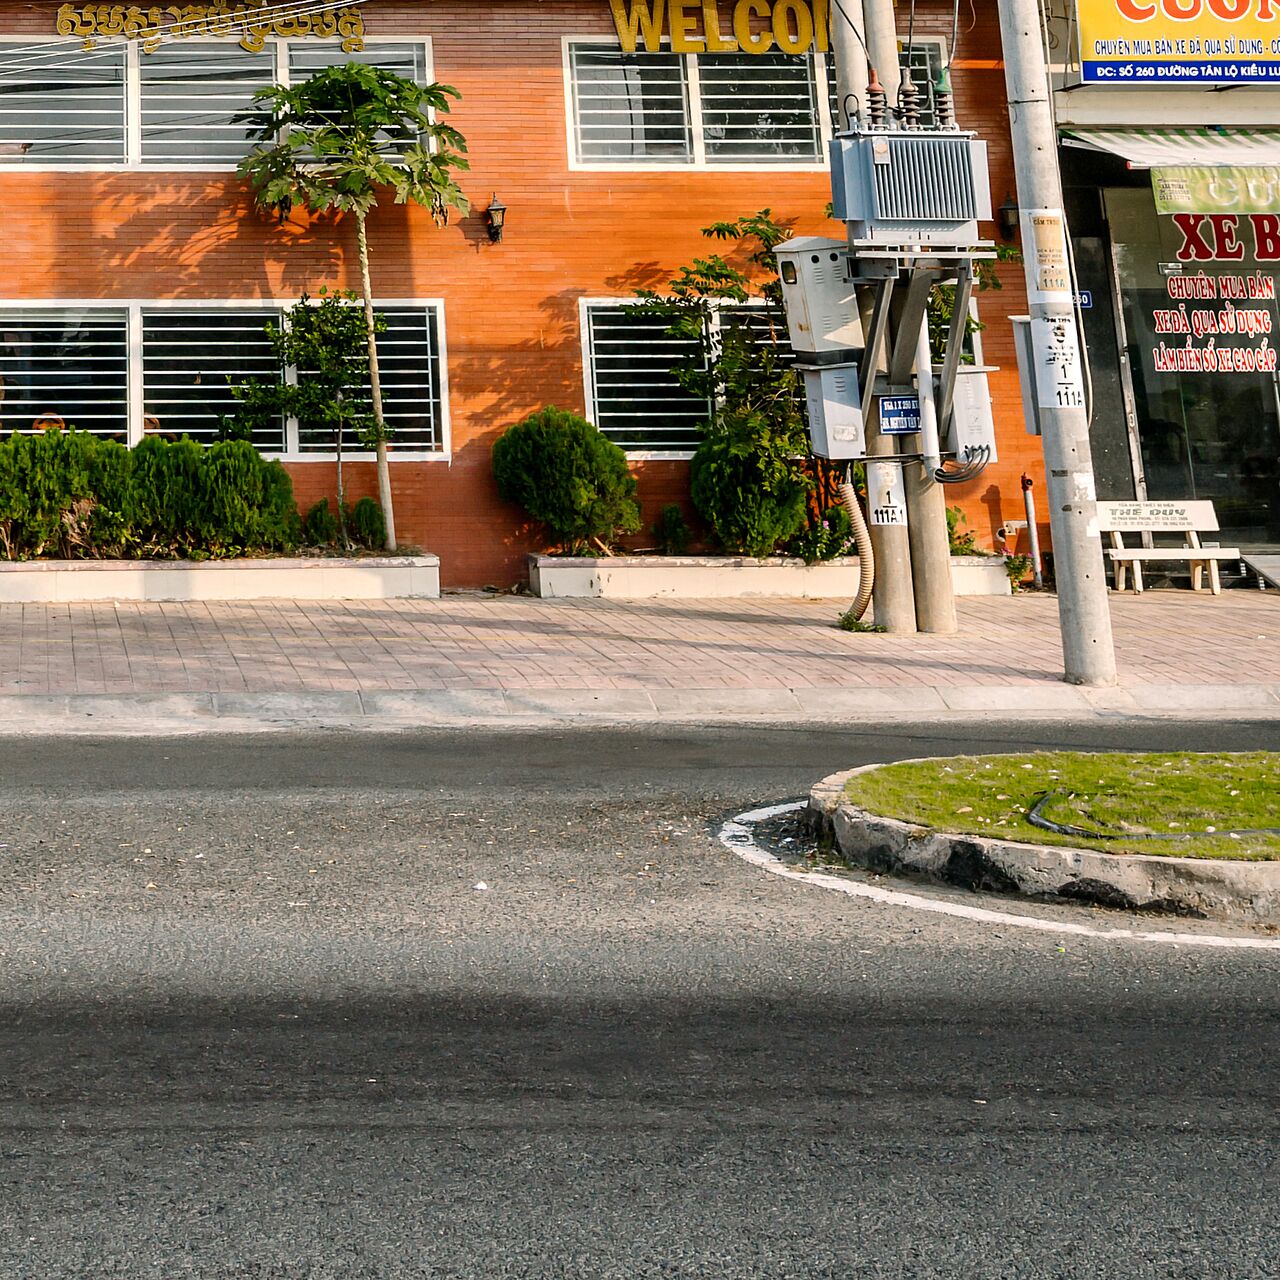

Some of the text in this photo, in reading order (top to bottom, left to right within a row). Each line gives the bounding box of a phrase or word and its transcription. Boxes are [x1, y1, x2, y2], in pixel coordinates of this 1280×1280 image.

[1095, 36, 1131, 55] CHUYÊN
[1133, 39, 1152, 55] MUA
[1155, 35, 1173, 55] BÁN
[1175, 39, 1186, 55] XE
[1189, 36, 1202, 55] ĐÃ
[1204, 39, 1222, 57] QUA
[1238, 39, 1264, 58] DỤNG
[1097, 66, 1117, 76] ĐC:
[1119, 63, 1133, 76] SỐ
[1136, 66, 1155, 76] 260
[1157, 64, 1199, 76] ĐƯỜNG
[1201, 64, 1222, 76] TÂN
[1224, 64, 1238, 78] LỘ
[1172, 213, 1245, 262] XE
[1168, 270, 1275, 299] CHUYÊN MUA BÁN
[1153, 301, 1272, 338] XE ĐÃ QUA SỬ DỤNG
[1153, 341, 1177, 372] LÀM
[1203, 337, 1217, 372] SỐ
[1217, 348, 1233, 372] XE
[1233, 348, 1255, 372] CAO
[1255, 337, 1277, 372] CẤP
